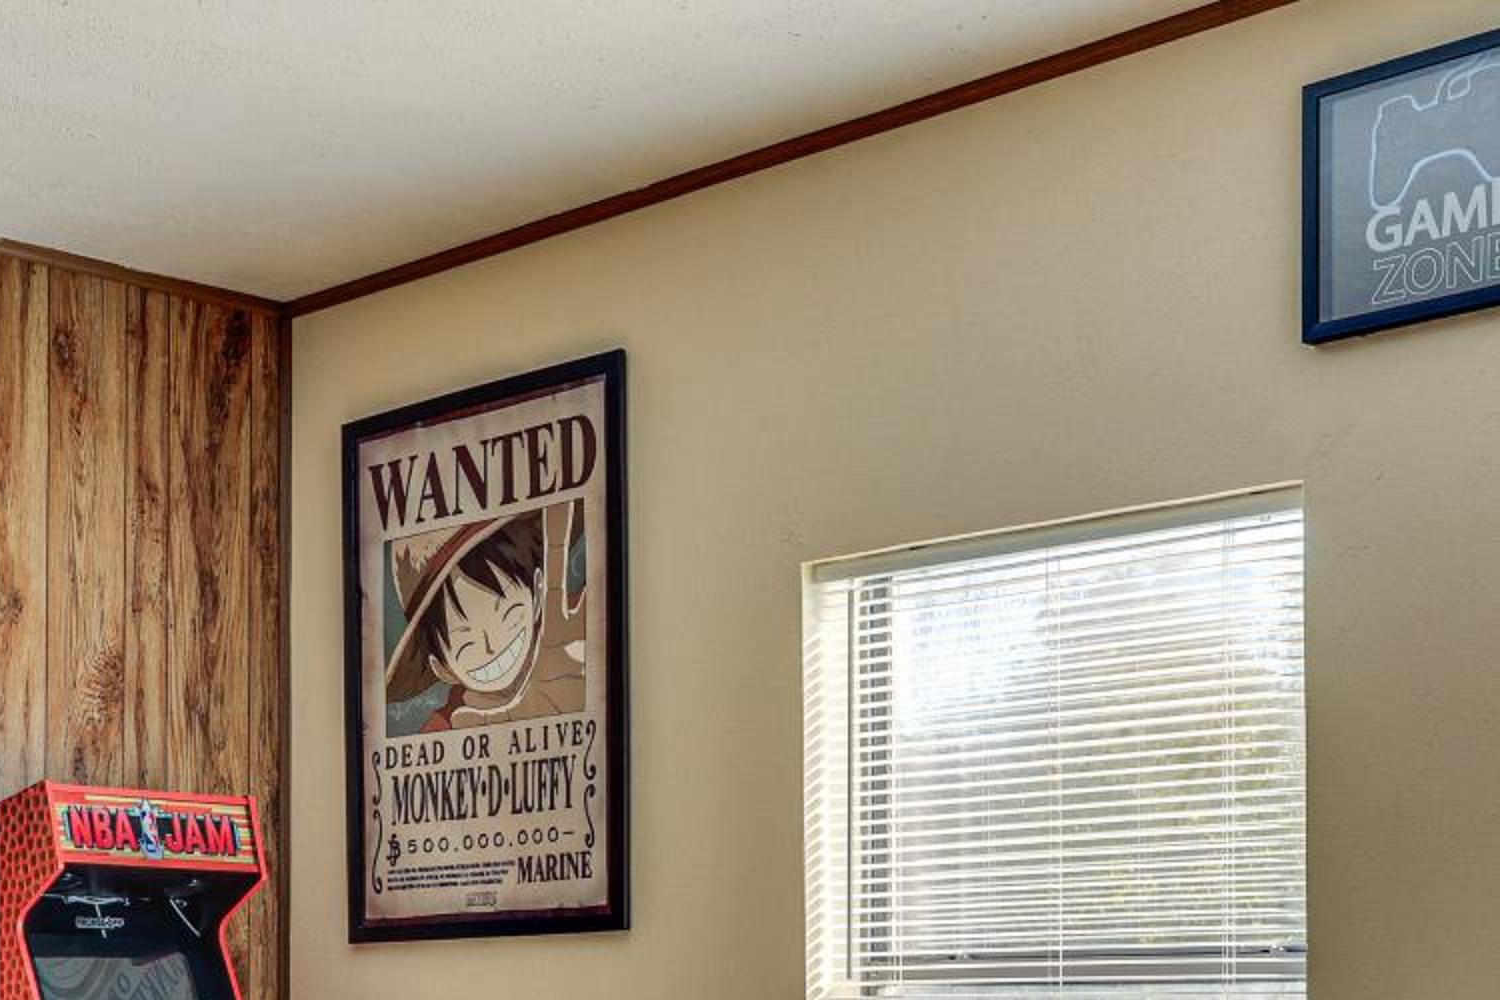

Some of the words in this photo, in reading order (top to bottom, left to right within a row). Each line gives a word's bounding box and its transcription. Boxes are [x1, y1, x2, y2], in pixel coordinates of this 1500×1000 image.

[368, 413, 597, 531] WANTED
[385, 740, 446, 770] DEAD
[462, 733, 490, 760] OR
[508, 720, 585, 755] ALIVE
[69, 805, 139, 850] NBA
[164, 812, 237, 856] JAM
[516, 850, 593, 884] MARINE
